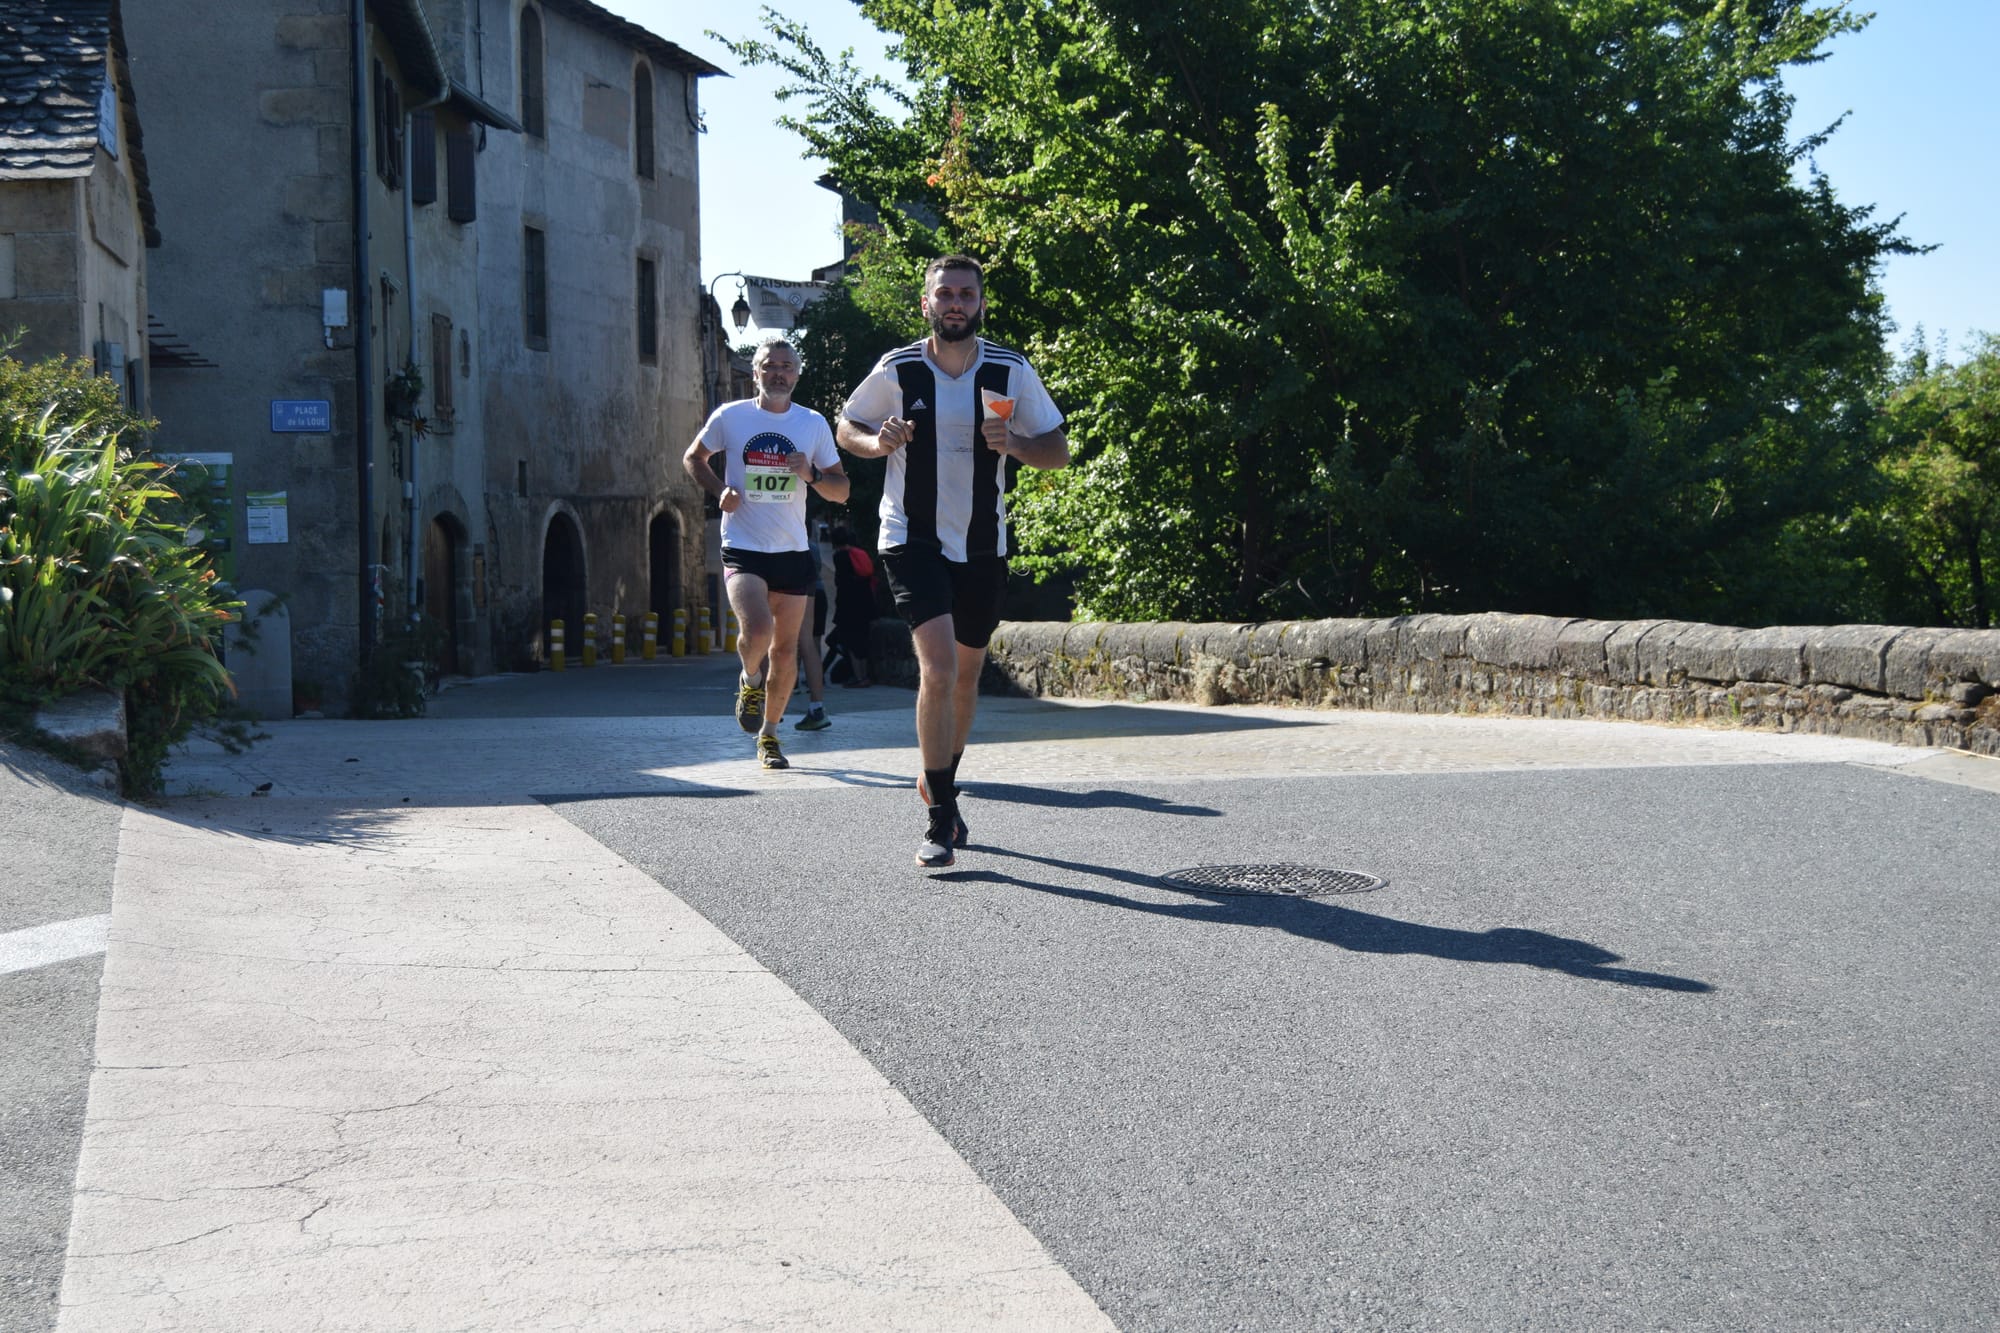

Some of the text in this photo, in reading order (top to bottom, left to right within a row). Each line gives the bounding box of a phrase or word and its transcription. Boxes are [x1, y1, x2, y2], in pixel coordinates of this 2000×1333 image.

[749, 278, 801, 288] MAISON
[295, 406, 318, 415] PLACE
[287, 417, 296, 426] de
[298, 417, 305, 426] la
[753, 475, 790, 491] 107
